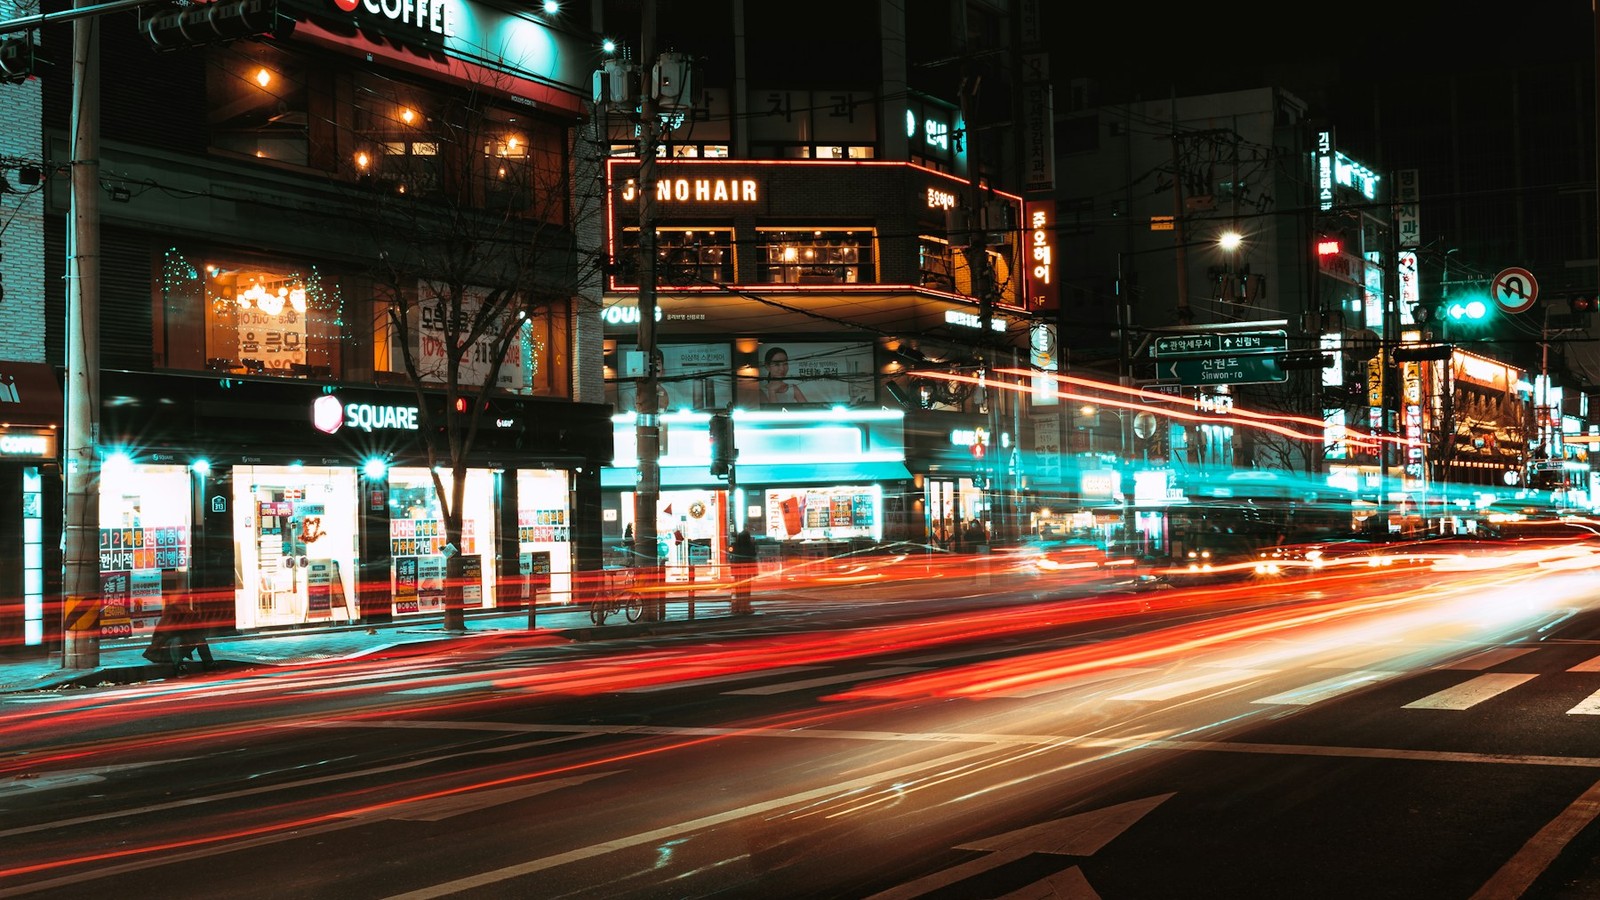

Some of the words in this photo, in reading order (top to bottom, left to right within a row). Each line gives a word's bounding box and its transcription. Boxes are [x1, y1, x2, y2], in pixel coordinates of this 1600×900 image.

[363, 0, 455, 37] COFFEE
[1319, 132, 1330, 154] 기구
[695, 179, 757, 201] HAIR
[927, 188, 955, 210] 준오헤어
[1032, 295, 1046, 306] 3F
[1170, 338, 1212, 351] 관악세무서
[701, 353, 725, 361] 스킨케어
[1201, 371, 1243, 380] Sinwon-ro
[345, 403, 419, 432] SQUARE
[769, 493, 780, 530] NETFLIX
